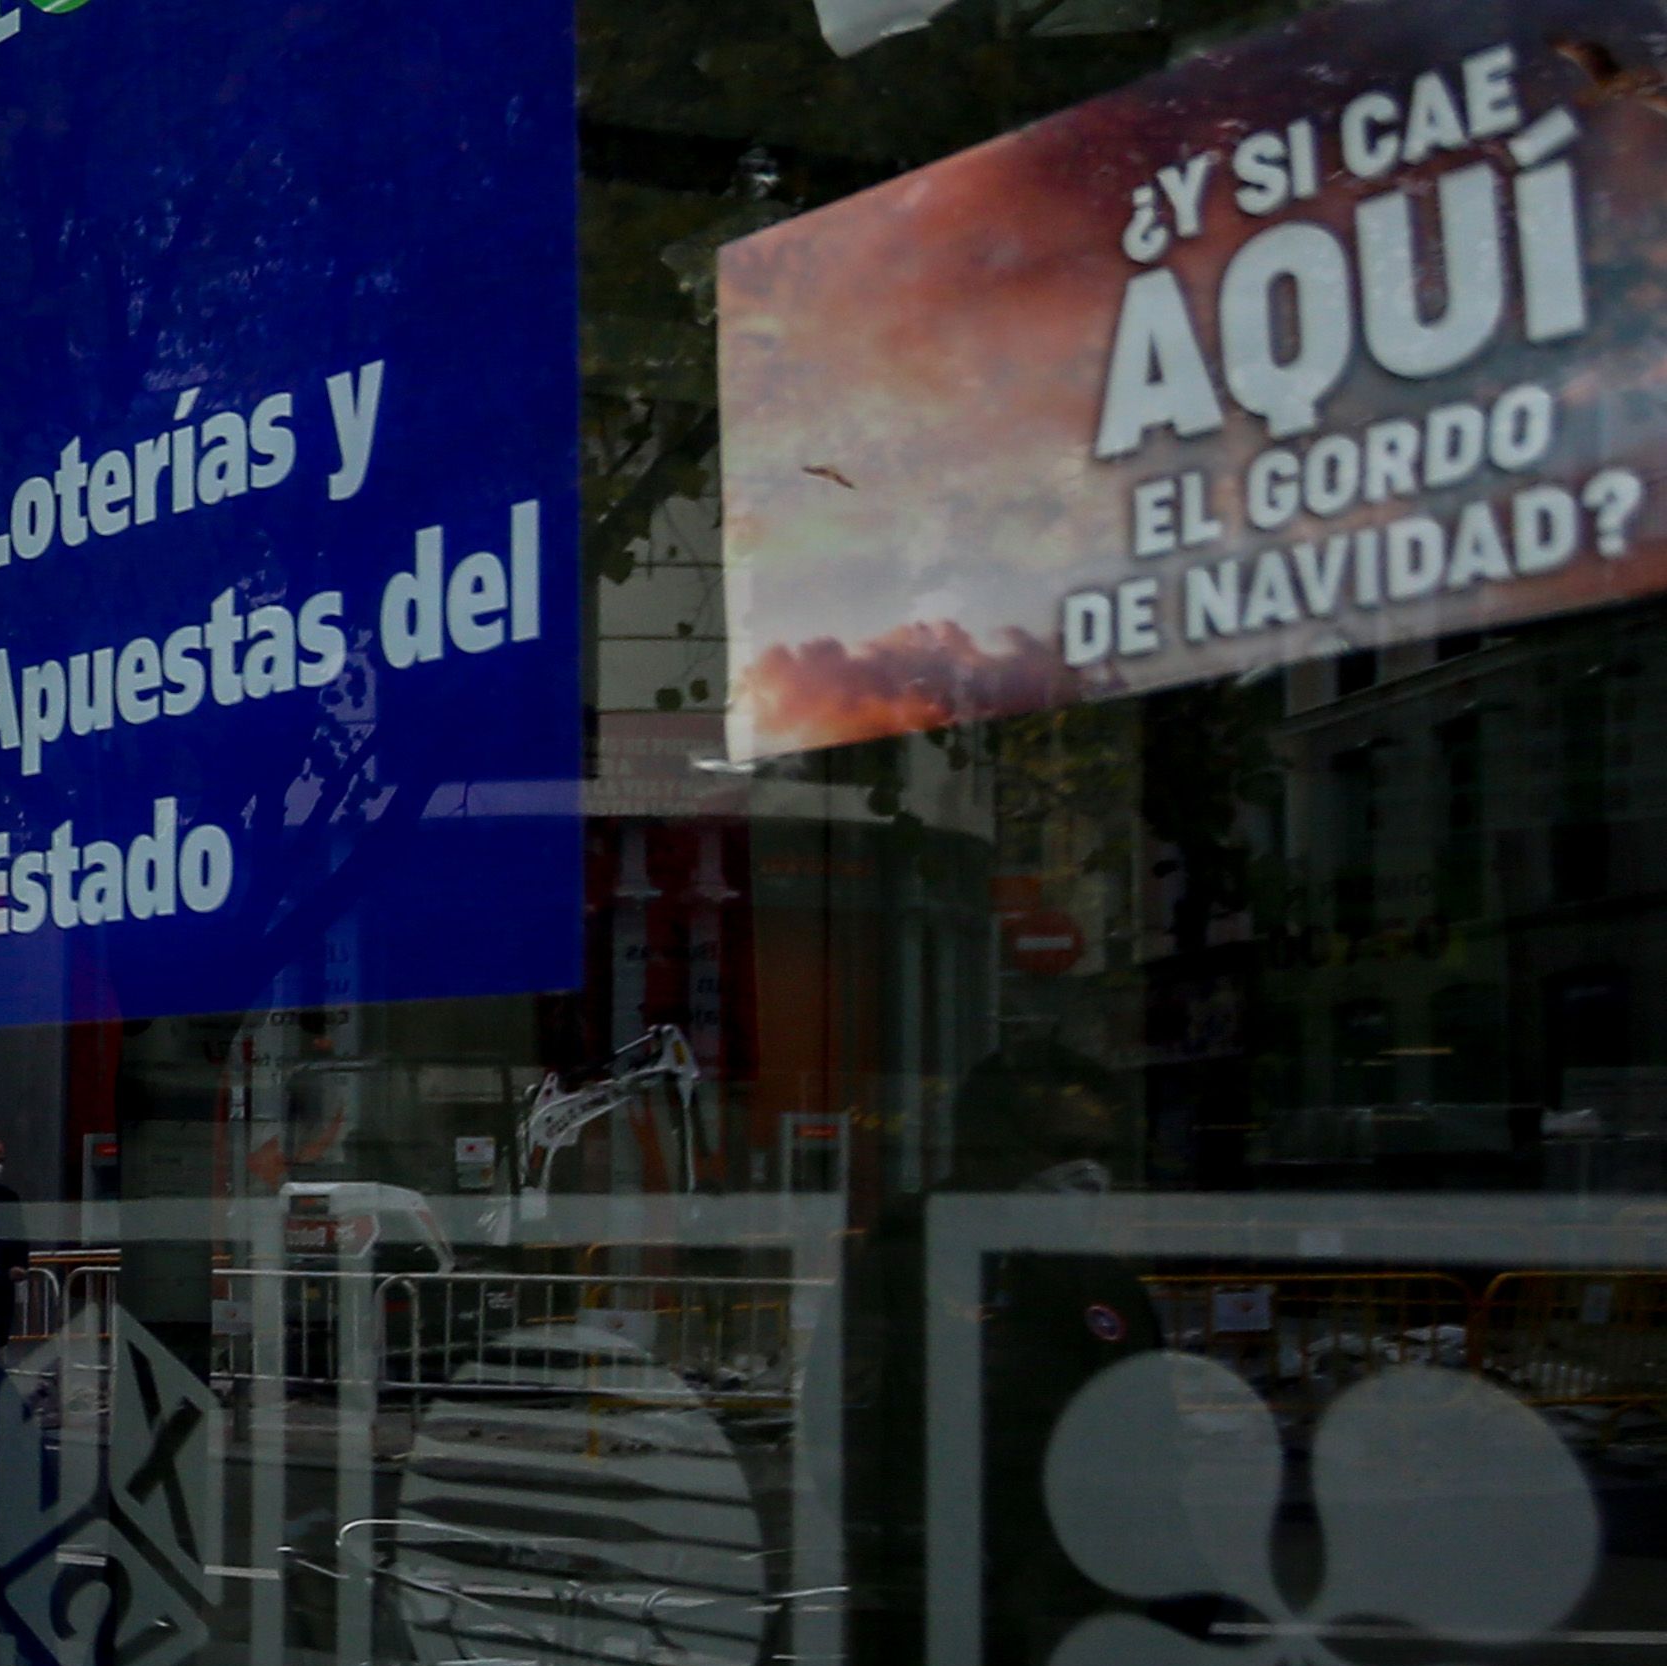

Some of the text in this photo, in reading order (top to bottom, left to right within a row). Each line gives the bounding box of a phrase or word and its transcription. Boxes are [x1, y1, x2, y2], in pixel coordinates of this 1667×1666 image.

[1122, 45, 1520, 263] ¿Y SI CAE
[1095, 108, 1589, 461] AQUÍ
[326, 359, 386, 502] y
[1133, 383, 1555, 558] EL GORDO
[379, 498, 541, 671] del
[1065, 471, 1645, 667] DE NAVIDAD?
